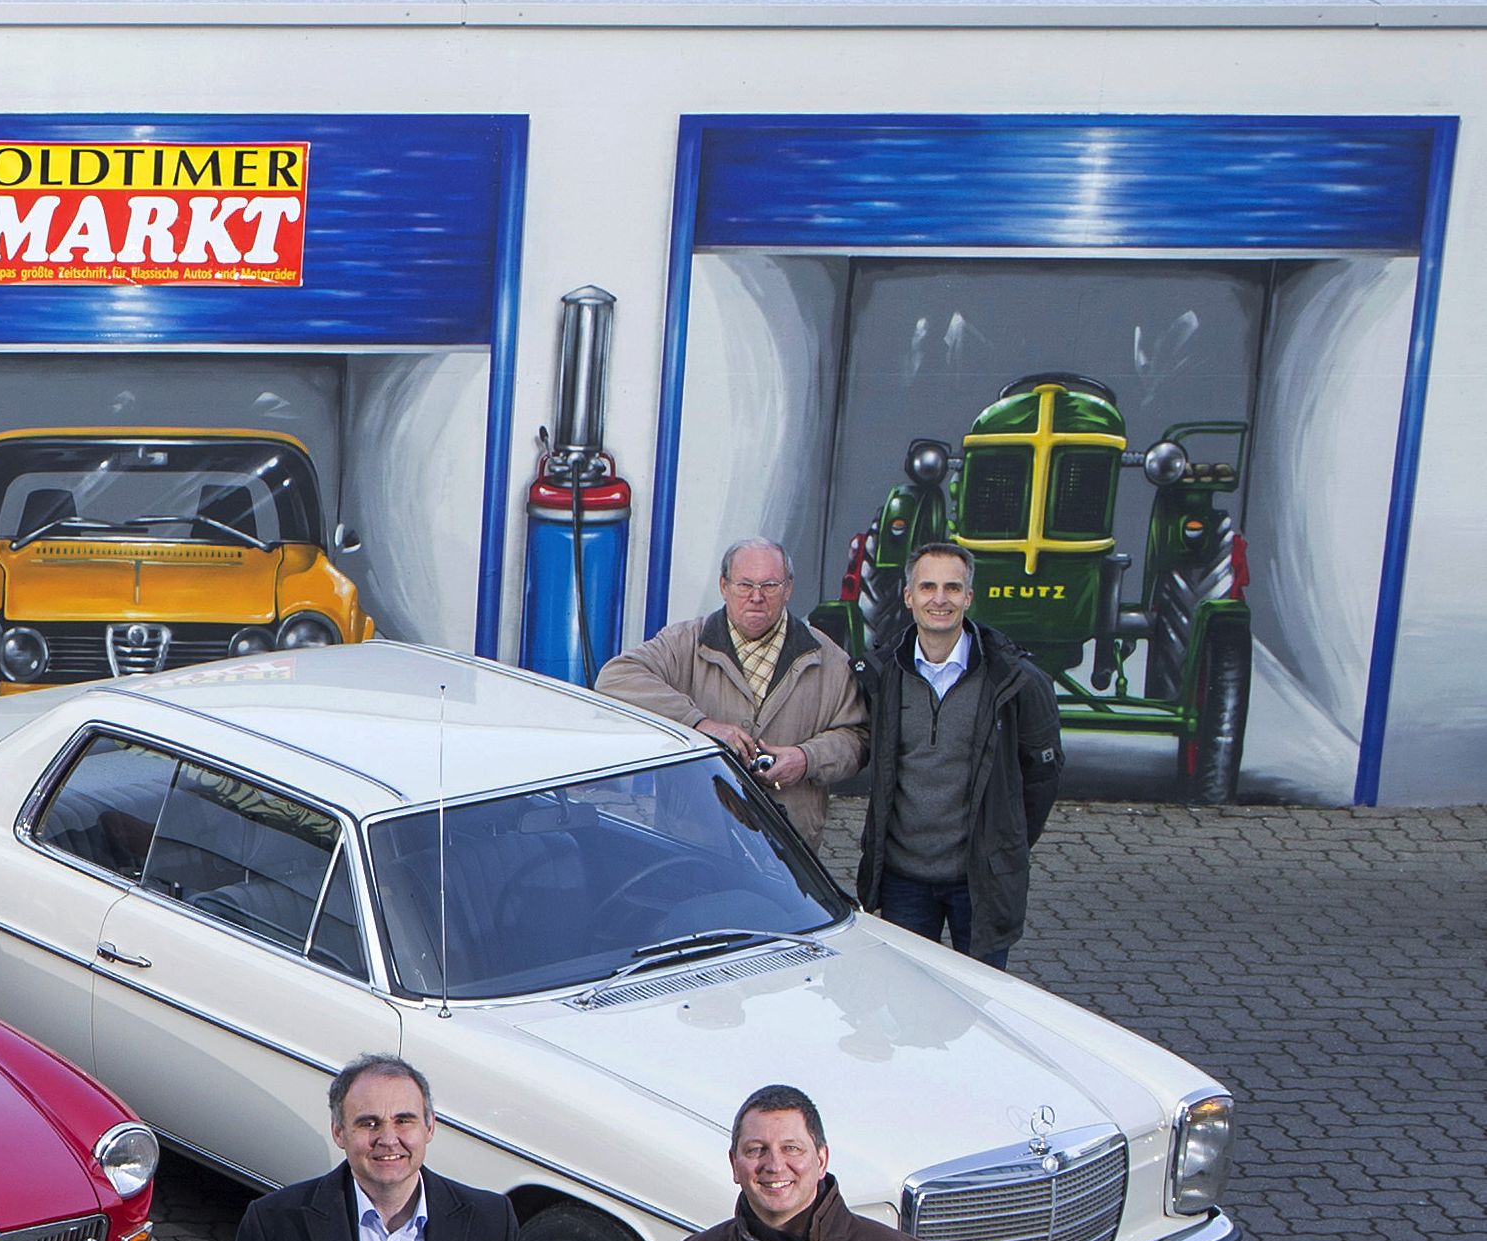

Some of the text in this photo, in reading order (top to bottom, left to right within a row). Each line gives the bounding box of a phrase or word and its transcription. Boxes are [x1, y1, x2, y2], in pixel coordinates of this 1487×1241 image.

[21, 266, 54, 281] größte
[58, 266, 107, 278] Zeitschrift
[112, 266, 126, 278] für
[183, 267, 212, 279] Autos
[240, 267, 296, 280] Motorräder
[989, 586, 1065, 598] DEUTZ
